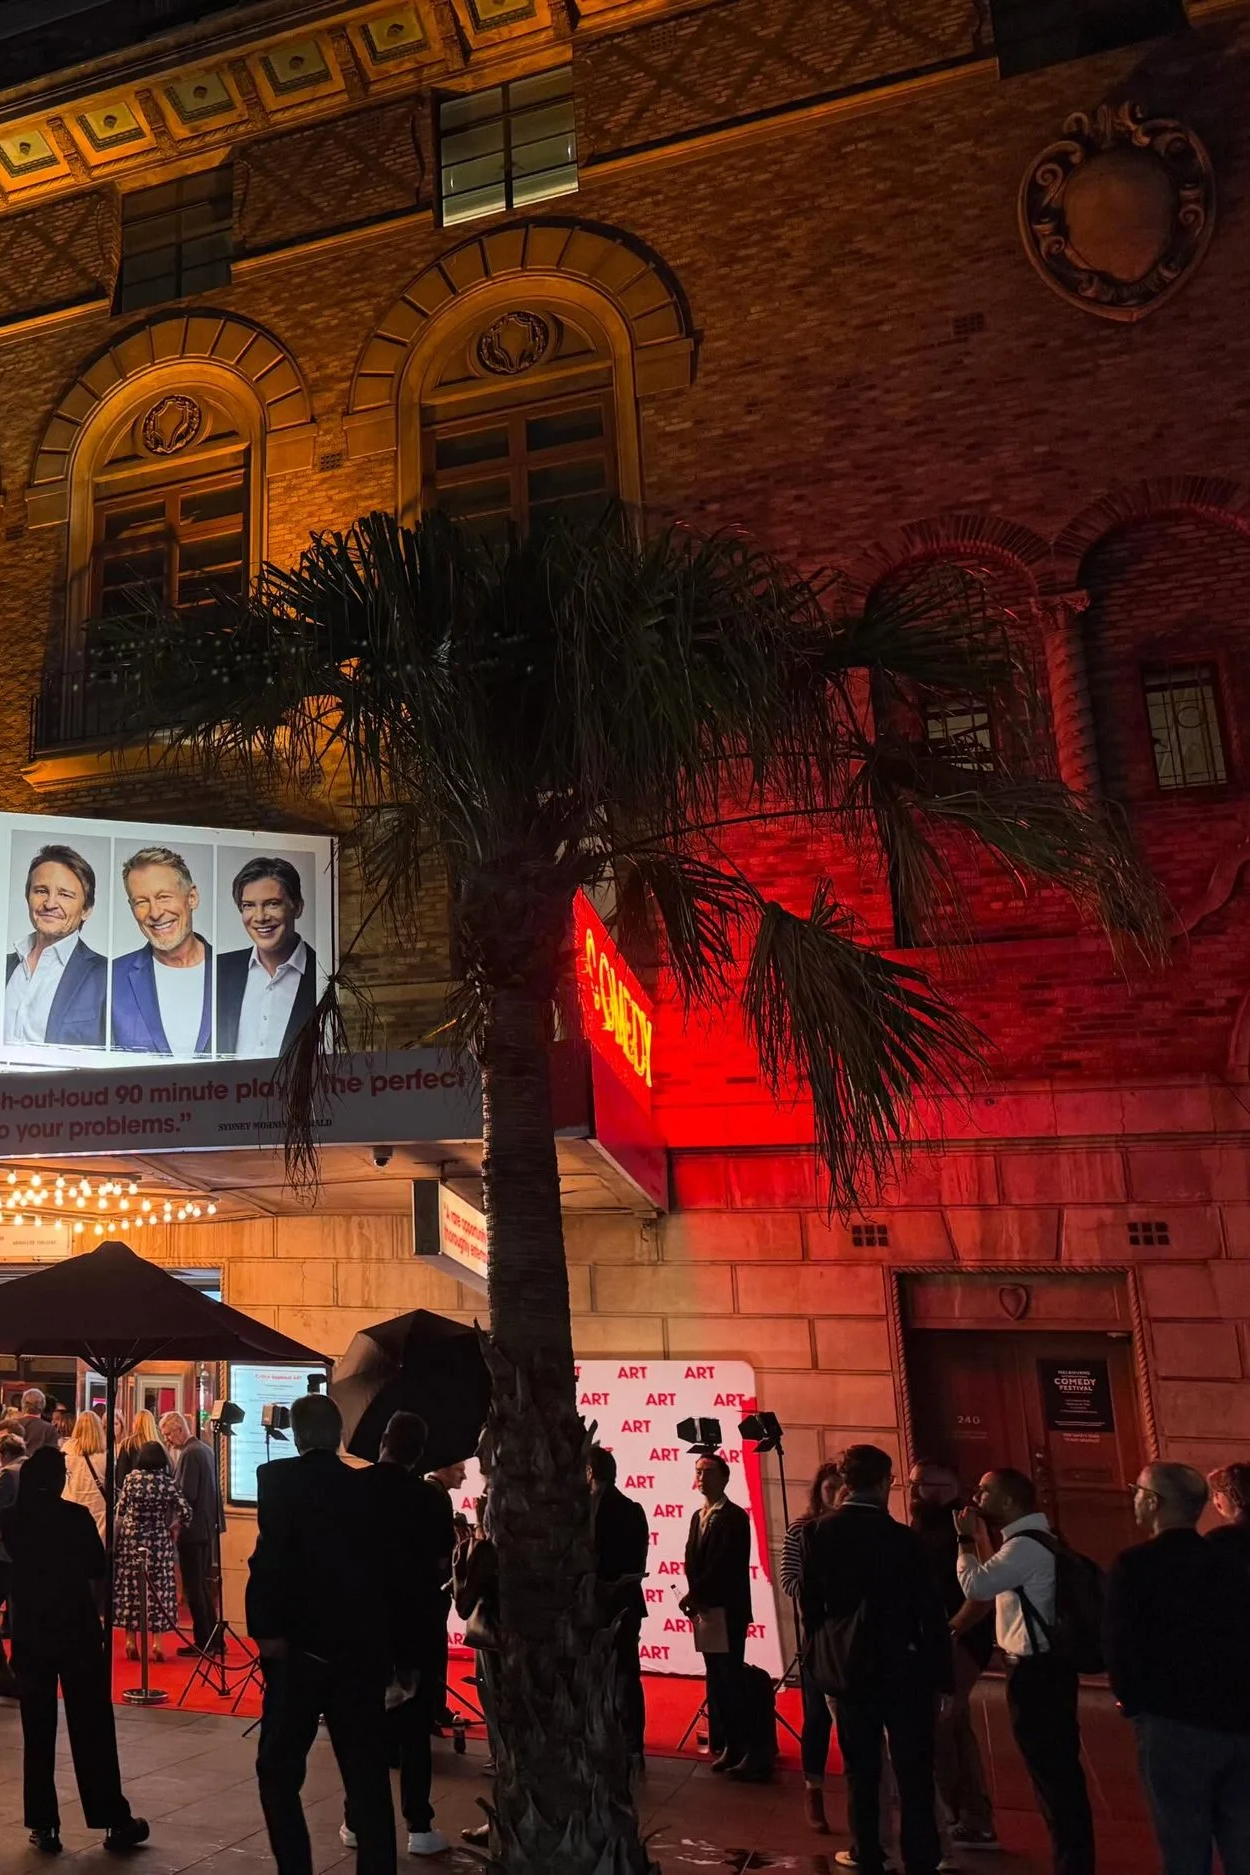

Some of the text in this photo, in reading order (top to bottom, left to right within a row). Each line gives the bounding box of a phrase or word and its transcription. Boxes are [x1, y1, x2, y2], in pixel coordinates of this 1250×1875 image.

[115, 1085, 142, 1104] 90
[150, 1080, 228, 1103] minute
[236, 1078, 288, 1103] play
[370, 1067, 466, 1097] perfect
[16, 1122, 64, 1143] your
[69, 1113, 191, 1141] problems.”
[217, 1122, 250, 1131] SYDNEY
[253, 1120, 290, 1130] MORNIN
[618, 1366, 715, 1379] ART ART
[1053, 1378, 1096, 1386] COMEDY
[580, 1393, 745, 1407] ART ART ART
[621, 1420, 651, 1433] ART
[649, 1448, 743, 1463] ART AR
[625, 1476, 655, 1489] ART
[653, 1504, 684, 1518] ART
[646, 1589, 664, 1602] RT
[664, 1618, 694, 1633] ART
[747, 1625, 766, 1638] RT
[639, 1645, 670, 1660] ART
